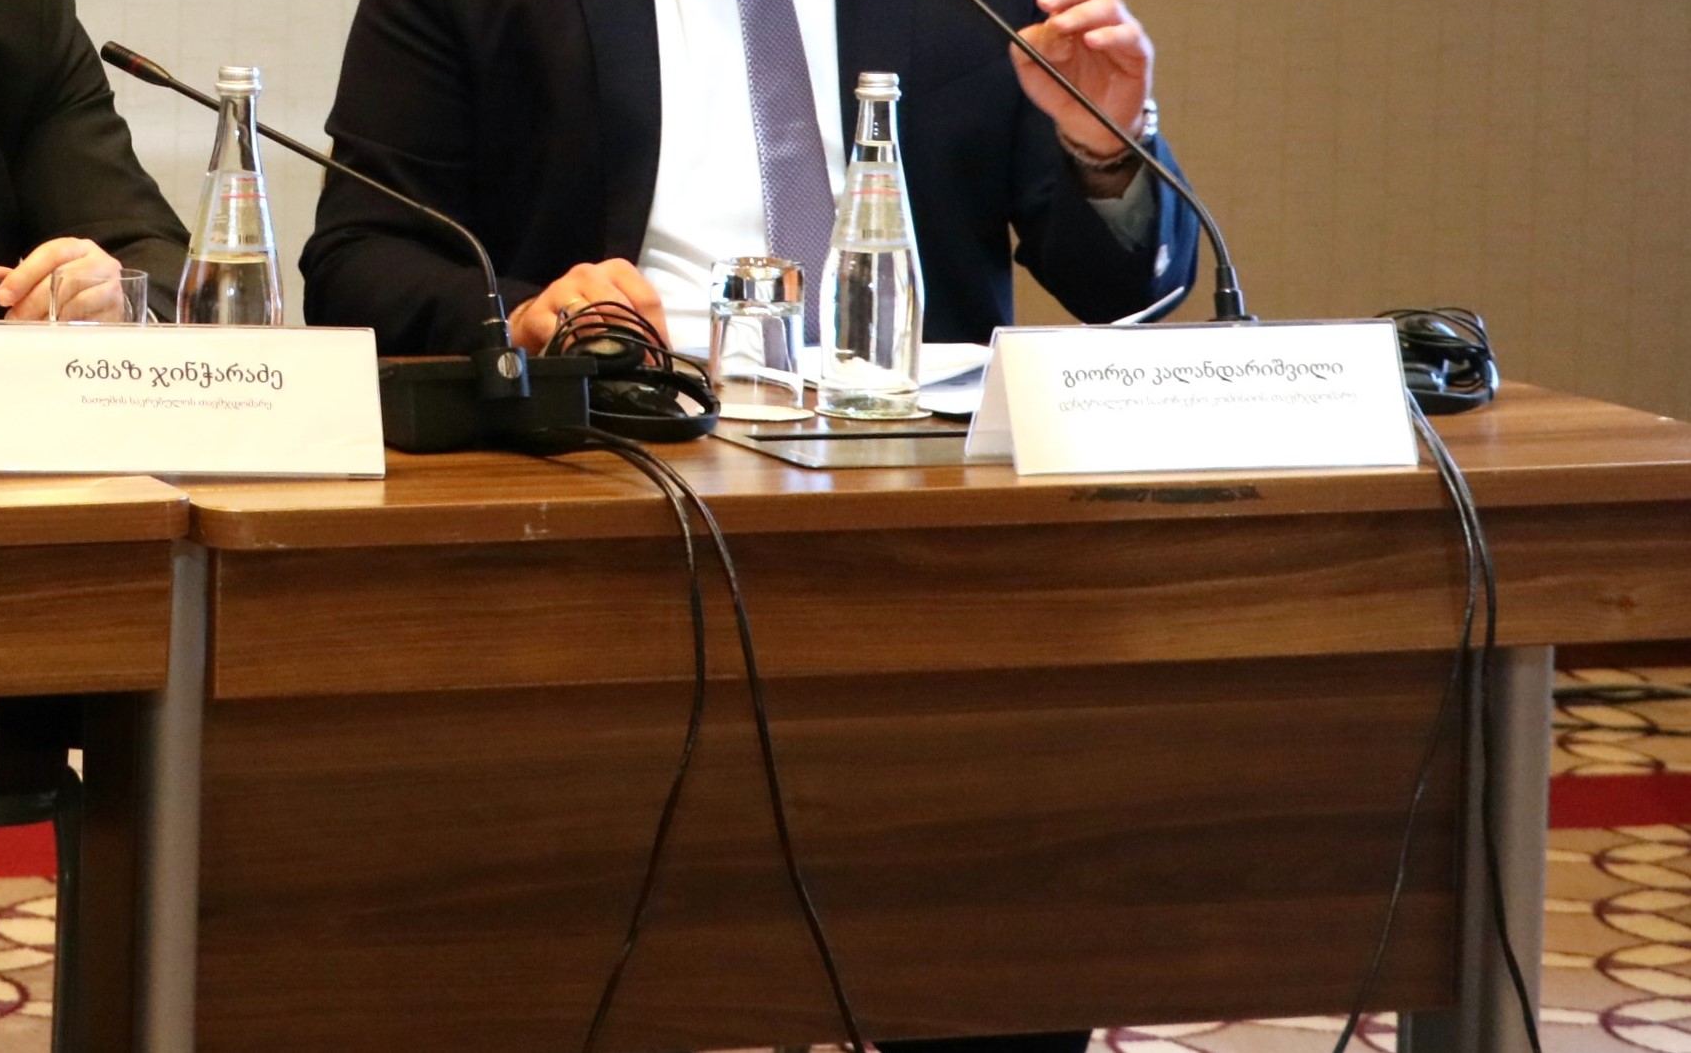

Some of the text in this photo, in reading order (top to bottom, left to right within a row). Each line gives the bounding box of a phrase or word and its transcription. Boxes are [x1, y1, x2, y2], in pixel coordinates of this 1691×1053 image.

[65, 359, 284, 390] რამაზ ჯინჭარაძე
[1062, 358, 1345, 388] გიორგი კალანდარიშვილი
